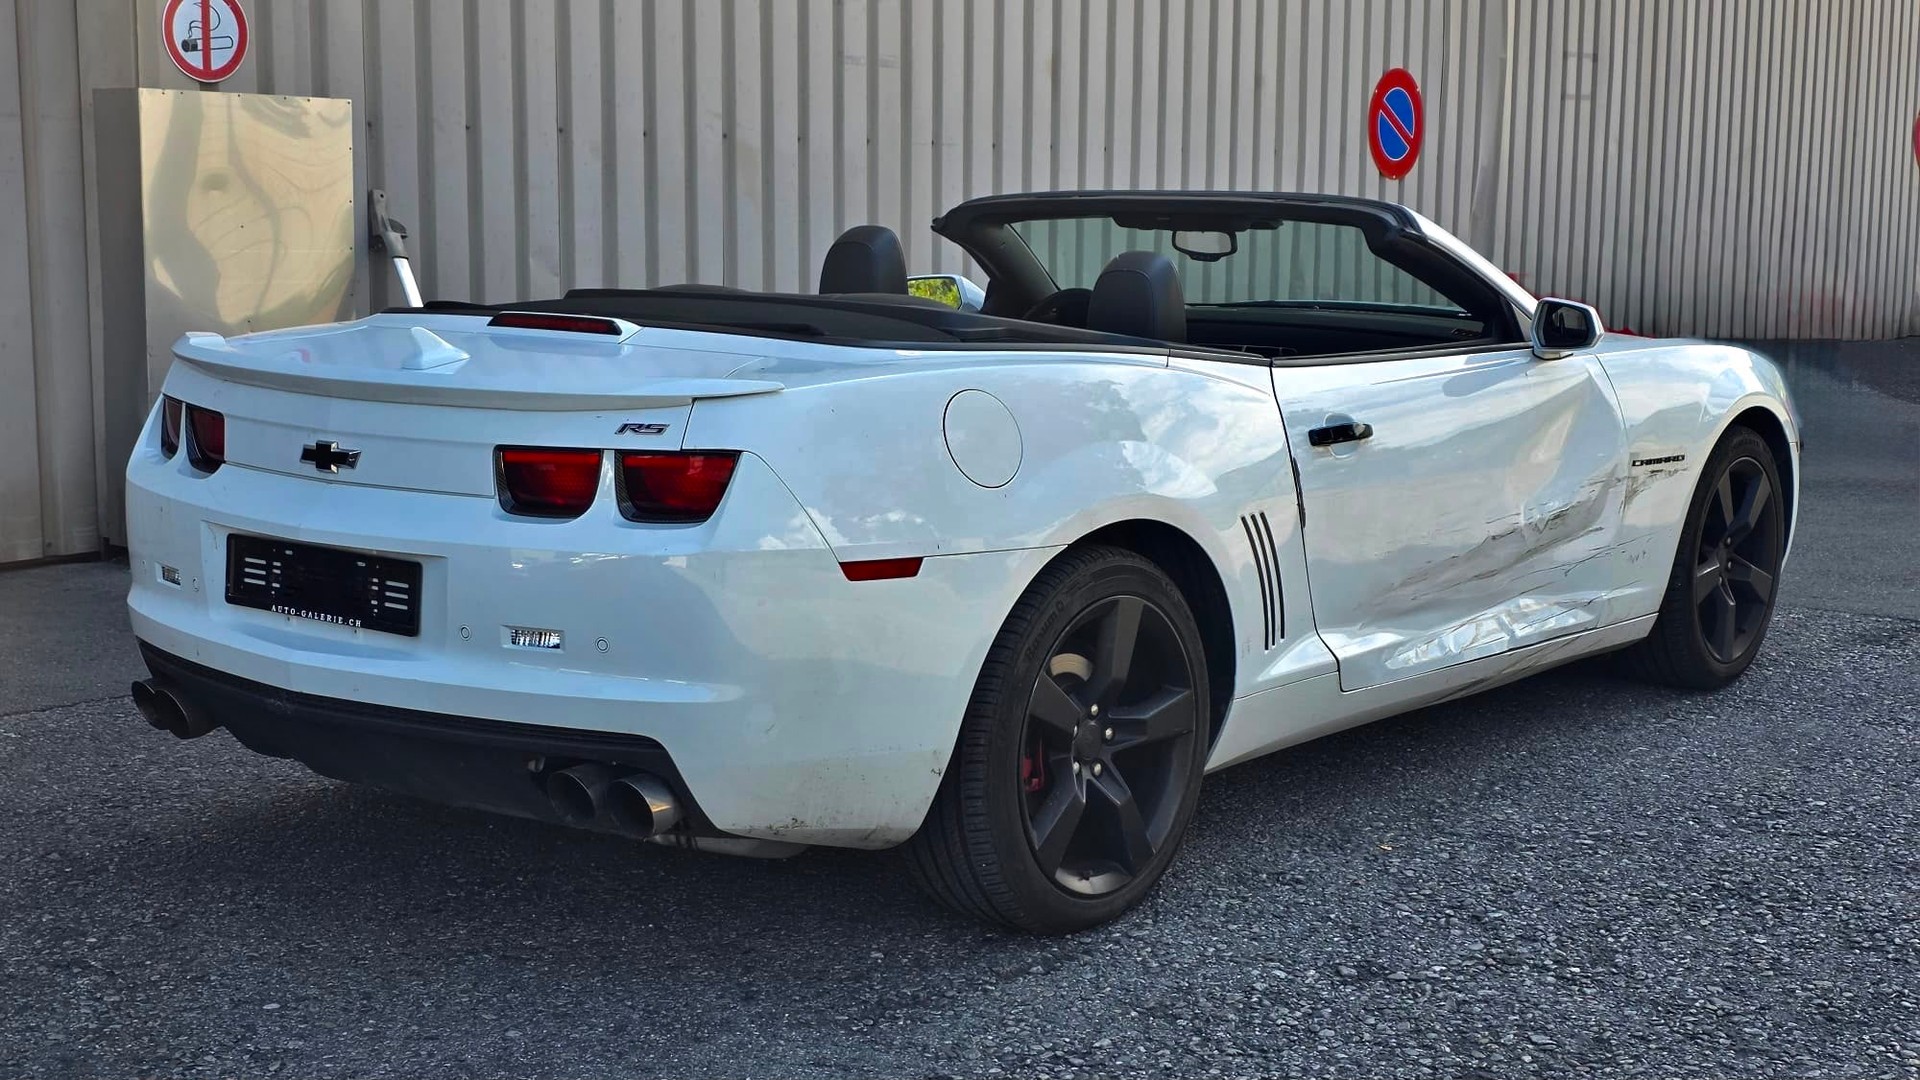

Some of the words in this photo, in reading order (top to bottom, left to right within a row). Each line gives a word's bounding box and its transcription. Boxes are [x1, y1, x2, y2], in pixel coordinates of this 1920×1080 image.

[614, 423, 670, 435] RS
[1631, 454, 1685, 467] CAMARO
[271, 604, 361, 627] AUTO-GALERIE.CH
